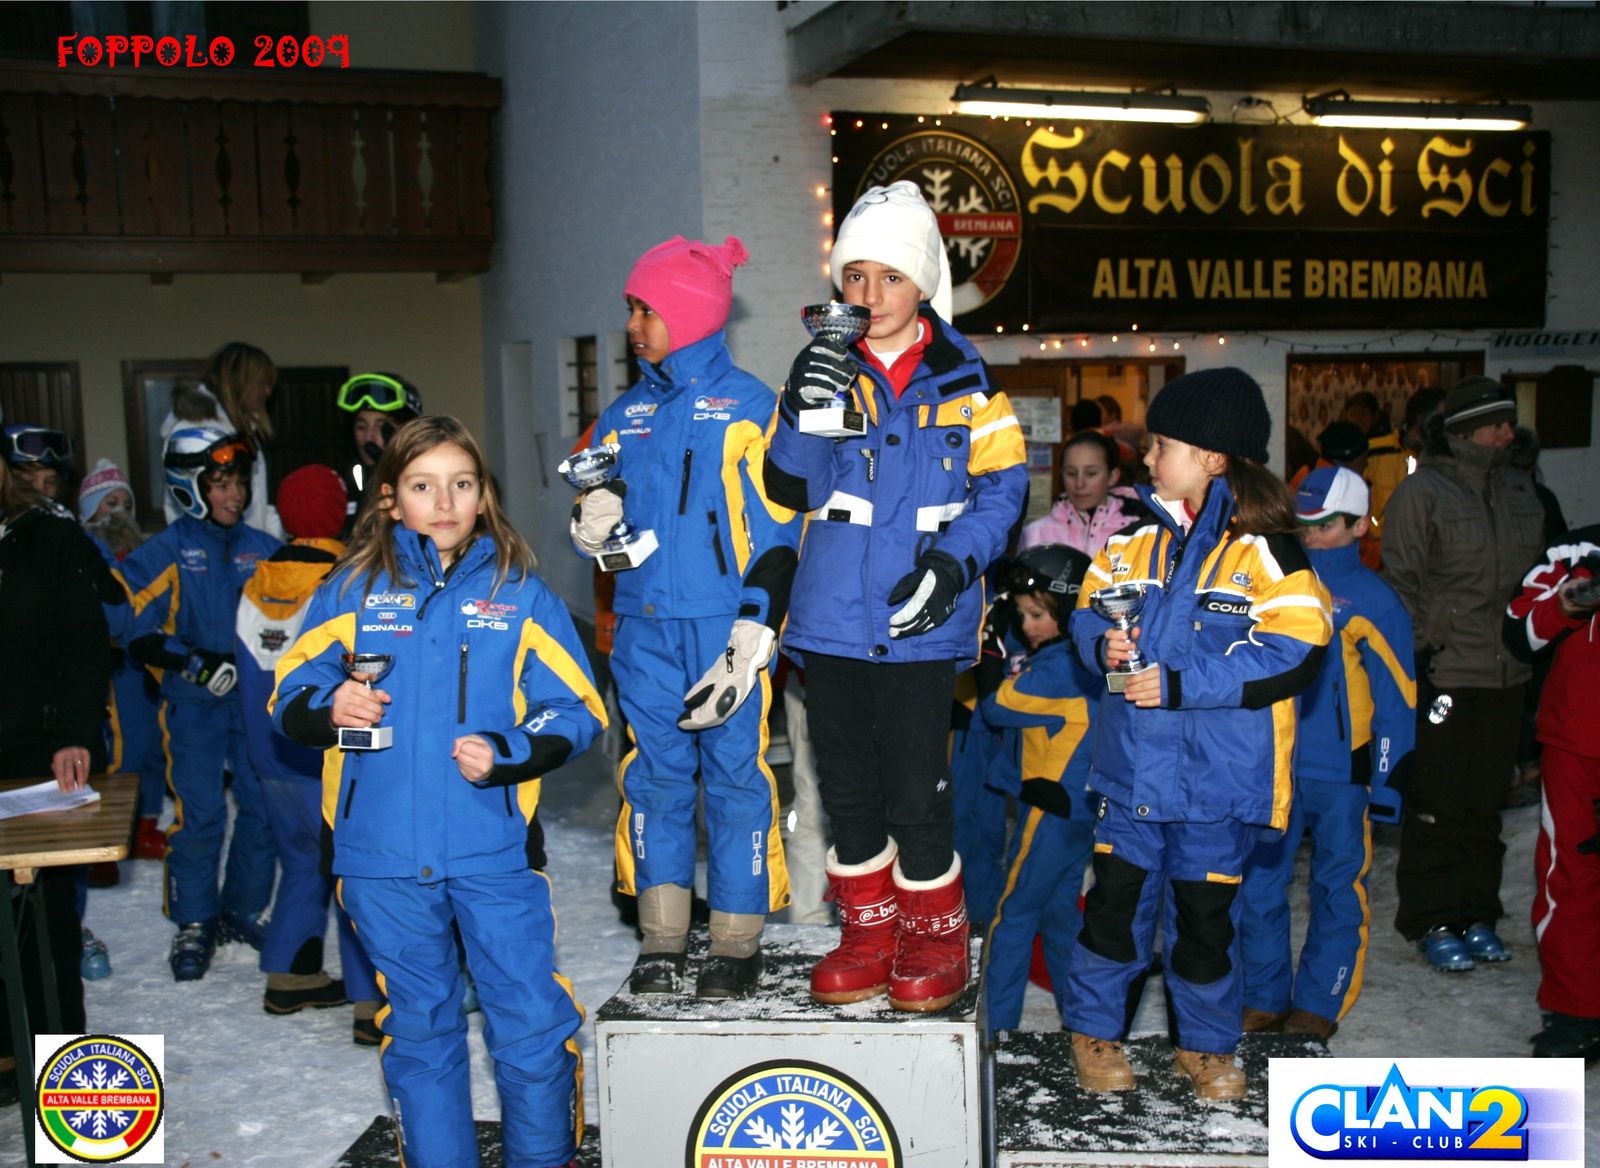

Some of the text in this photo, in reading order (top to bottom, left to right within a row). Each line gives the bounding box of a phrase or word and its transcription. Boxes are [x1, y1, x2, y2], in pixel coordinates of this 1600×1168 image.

[867, 138, 1013, 209] UOLA ITALIANA SCI
[1021, 126, 1538, 218] Scuola di Sci
[953, 219, 1014, 232] BREMBANA
[1092, 258, 1488, 299] ALTA VALLE BREMBANA
[467, 619, 509, 631] DKB
[709, 1076, 881, 1146] SCUOLA ITALIANA SCI
